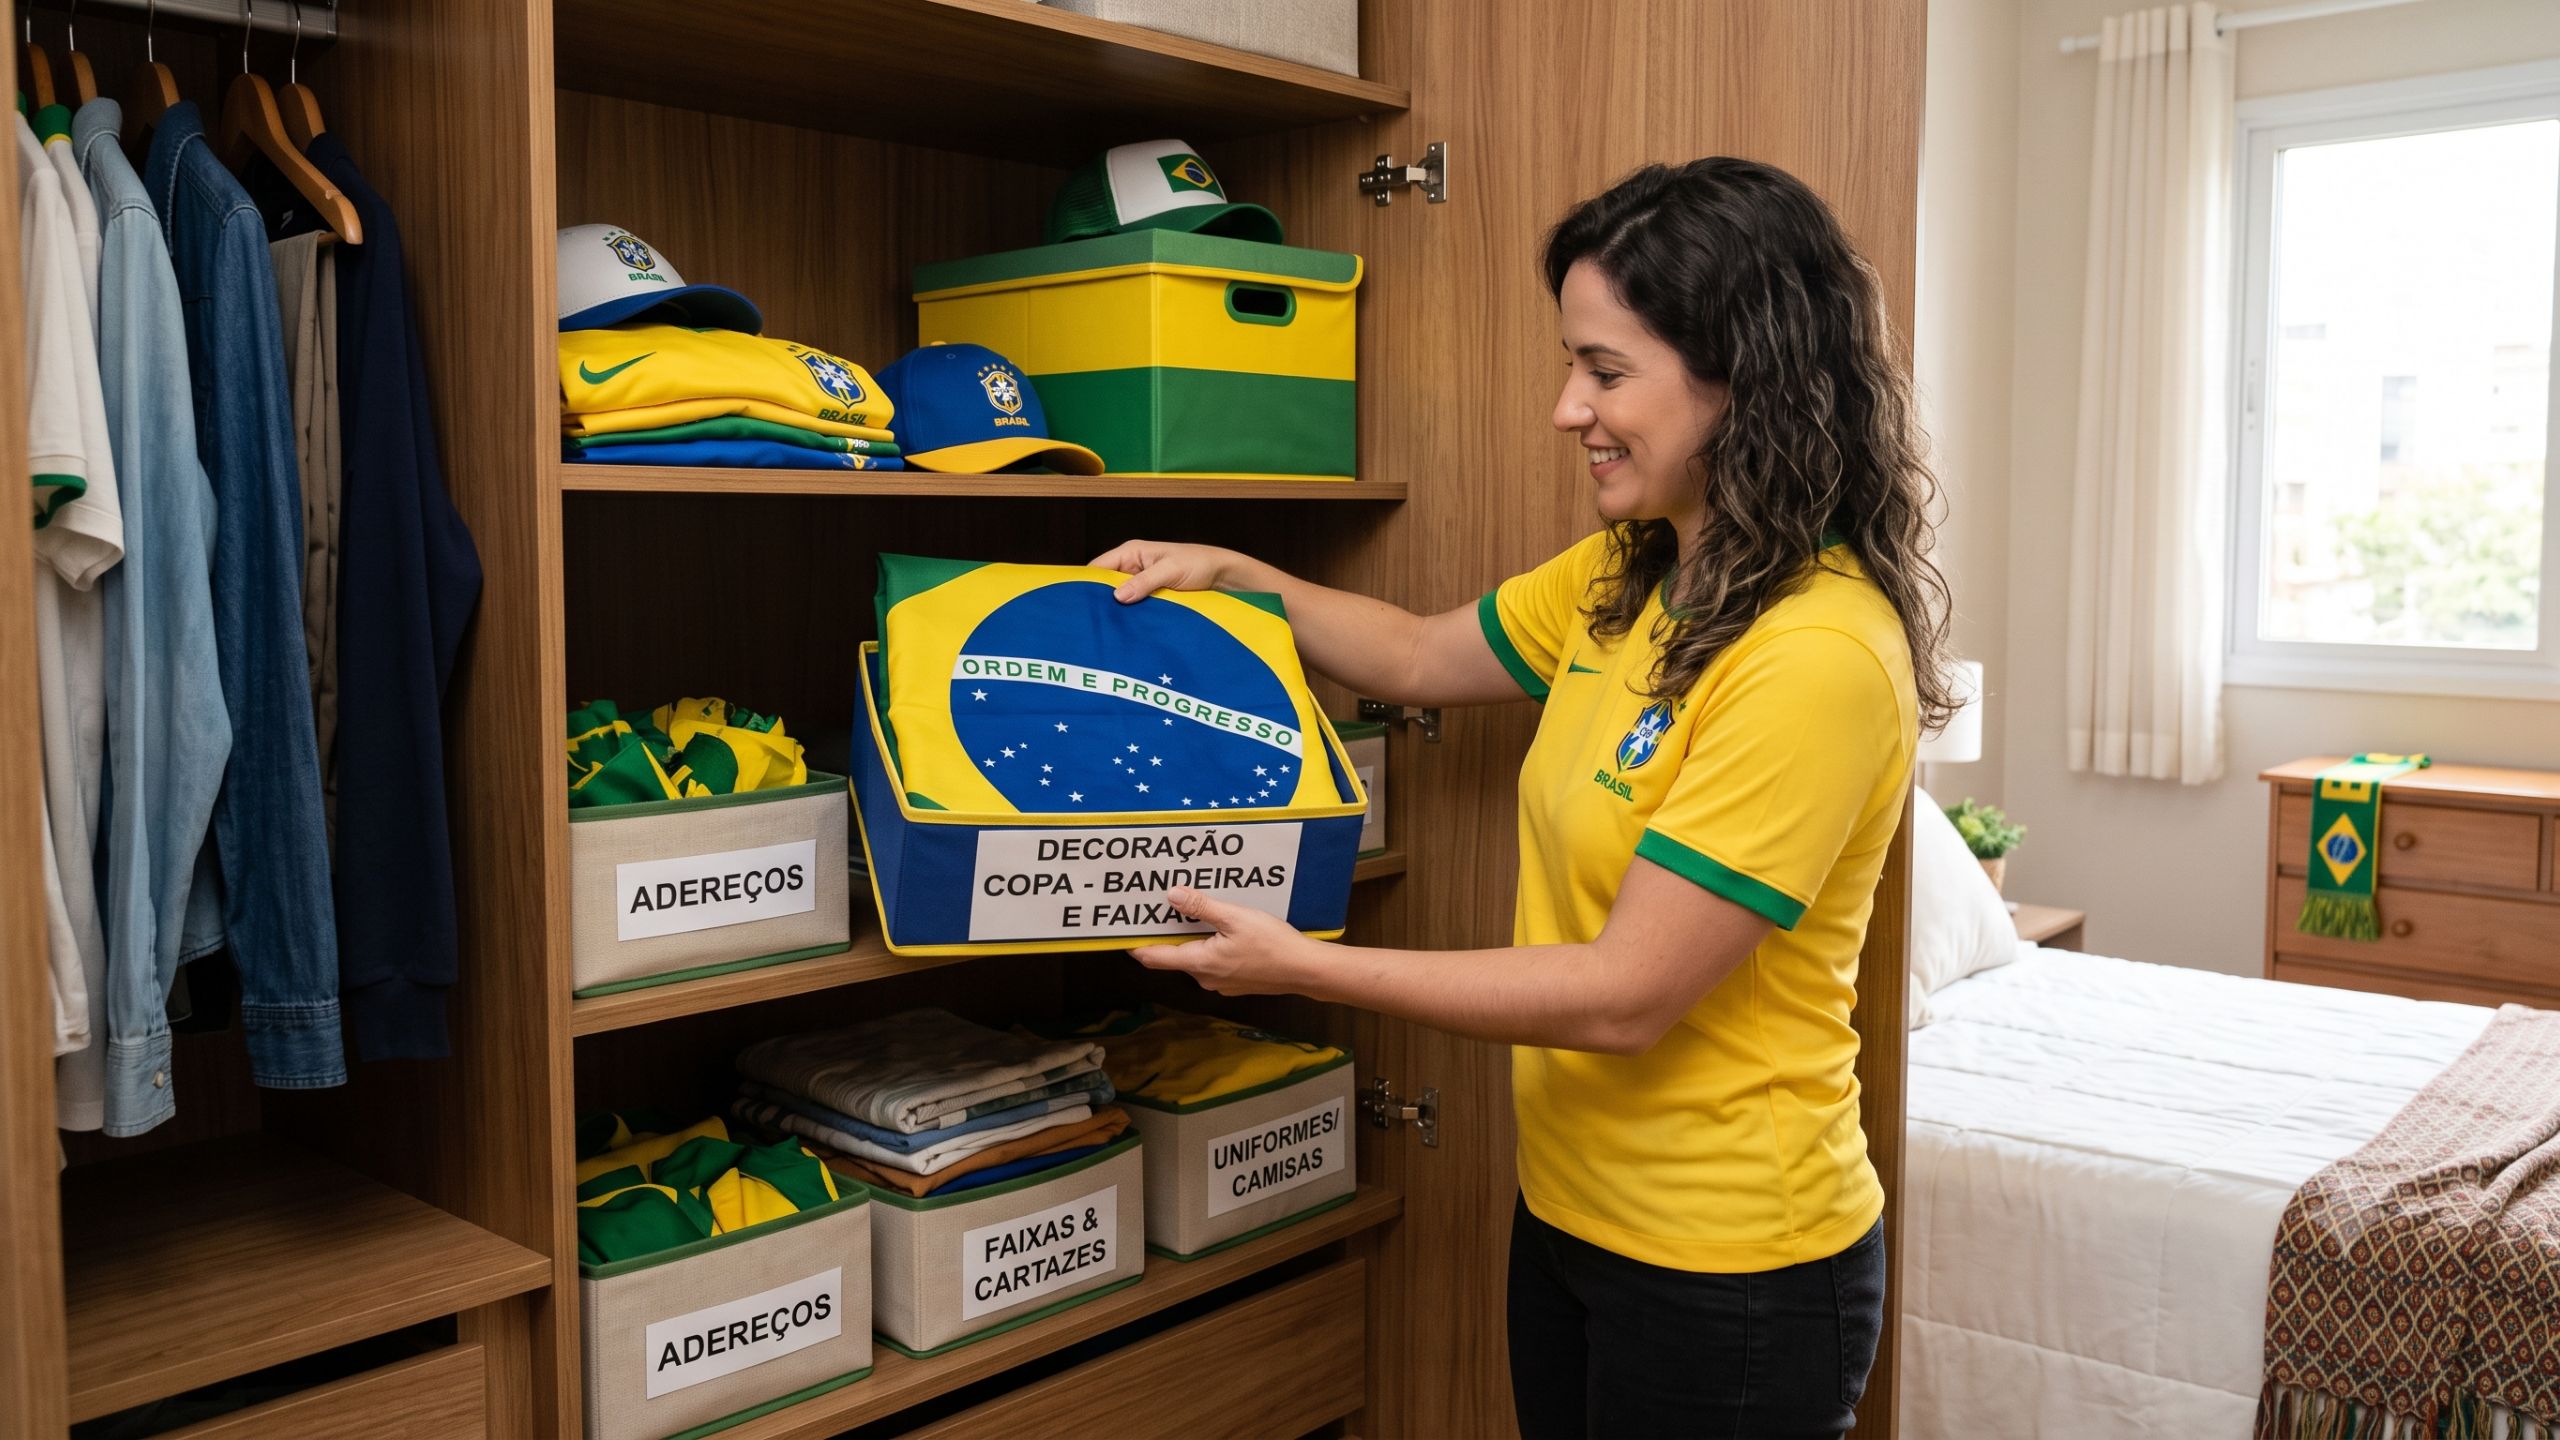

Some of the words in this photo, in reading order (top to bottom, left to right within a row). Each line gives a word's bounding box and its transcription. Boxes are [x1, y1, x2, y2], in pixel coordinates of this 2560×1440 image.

[816, 408, 867, 426] BRASIL
[962, 658, 1067, 683] ORDEM
[1082, 672, 1098, 689] E
[1112, 677, 1294, 747] PROGRESSO
[1593, 768, 1634, 802] BRASIL
[1037, 830, 1244, 863] DECORAÇÃO
[630, 864, 804, 914] ADEREÇOS
[983, 873, 1074, 897] COPA
[1102, 865, 1286, 893] BANDEIRAS
[1062, 906, 1082, 928] E
[1214, 1107, 1340, 1170] UNIFORMES/
[1232, 1147, 1324, 1197] CAMISAS
[985, 1214, 1075, 1263] FAIXAS
[1082, 1207, 1098, 1232] &
[974, 1238, 1106, 1301] CARTAZES
[657, 1293, 832, 1373] ADEREÇOS
